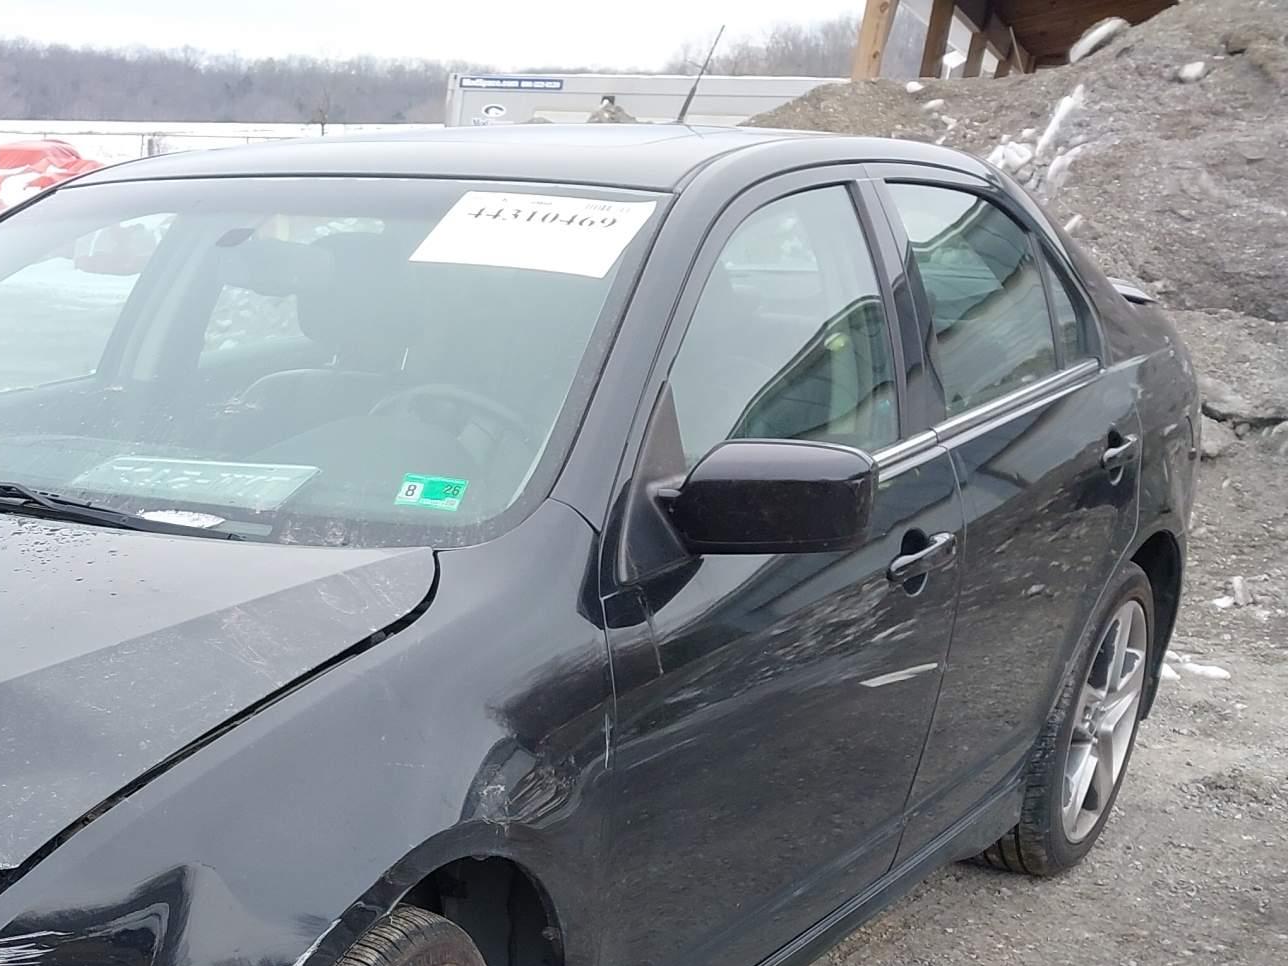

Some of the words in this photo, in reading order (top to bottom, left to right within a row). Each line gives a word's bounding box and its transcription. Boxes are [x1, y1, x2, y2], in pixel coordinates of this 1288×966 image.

[468, 207, 617, 228] 44310469
[404, 484, 417, 497] 8
[442, 484, 462, 497] 26
